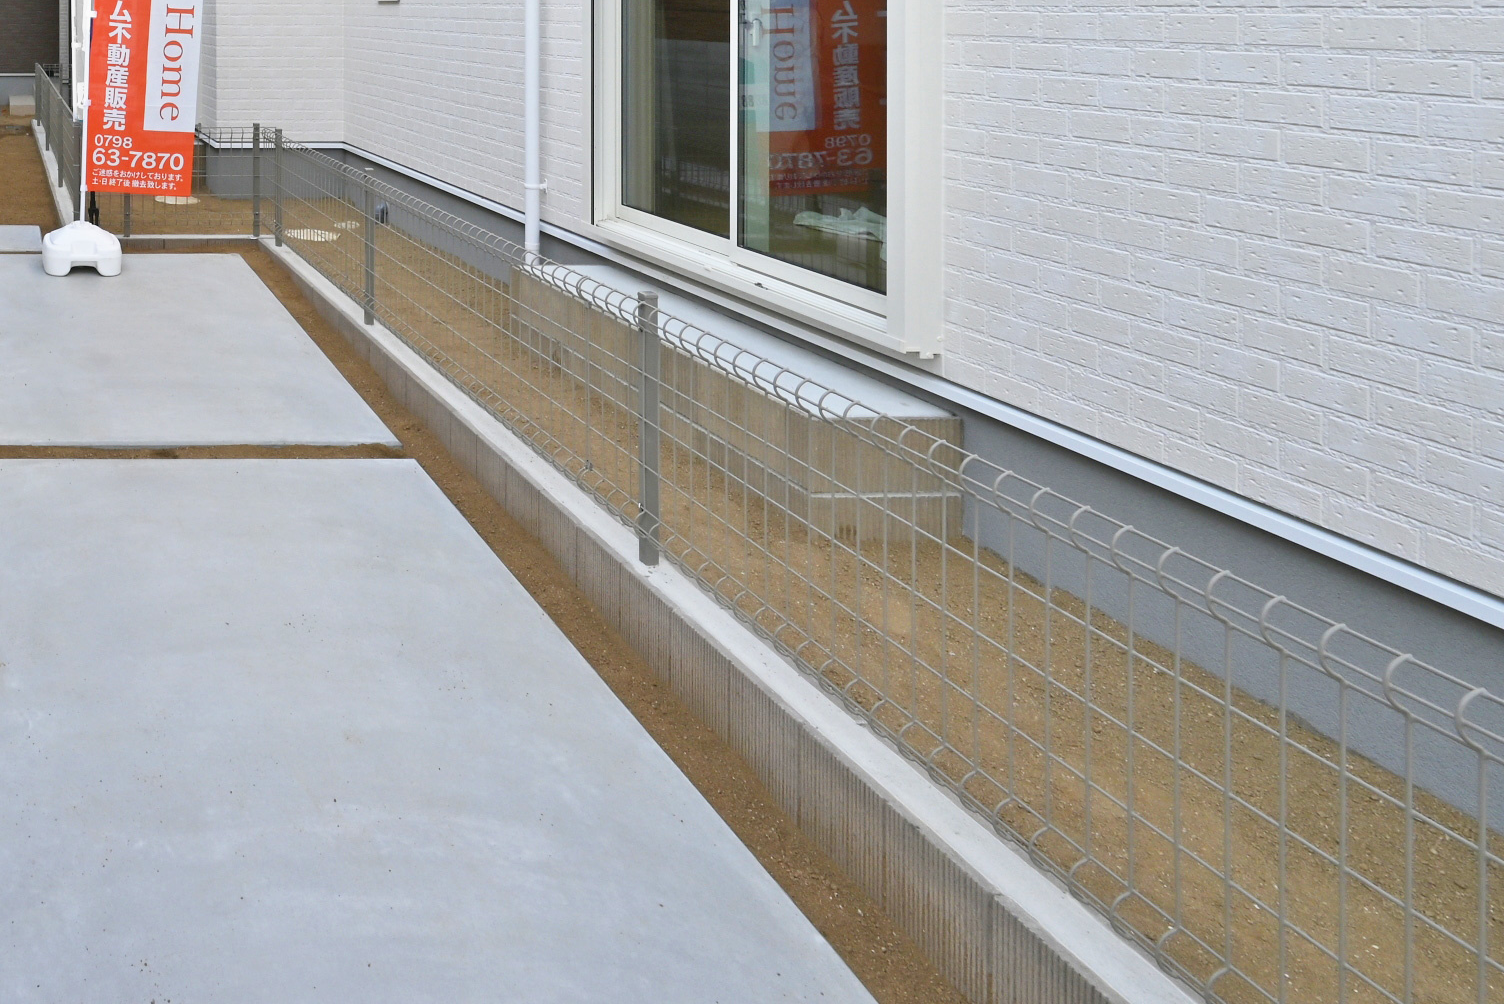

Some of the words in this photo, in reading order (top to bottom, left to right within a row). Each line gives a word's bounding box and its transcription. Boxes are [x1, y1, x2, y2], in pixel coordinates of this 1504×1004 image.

[159, 3, 195, 121] Home
[94, 133, 133, 149] 0798
[92, 147, 185, 171] 63-7870
